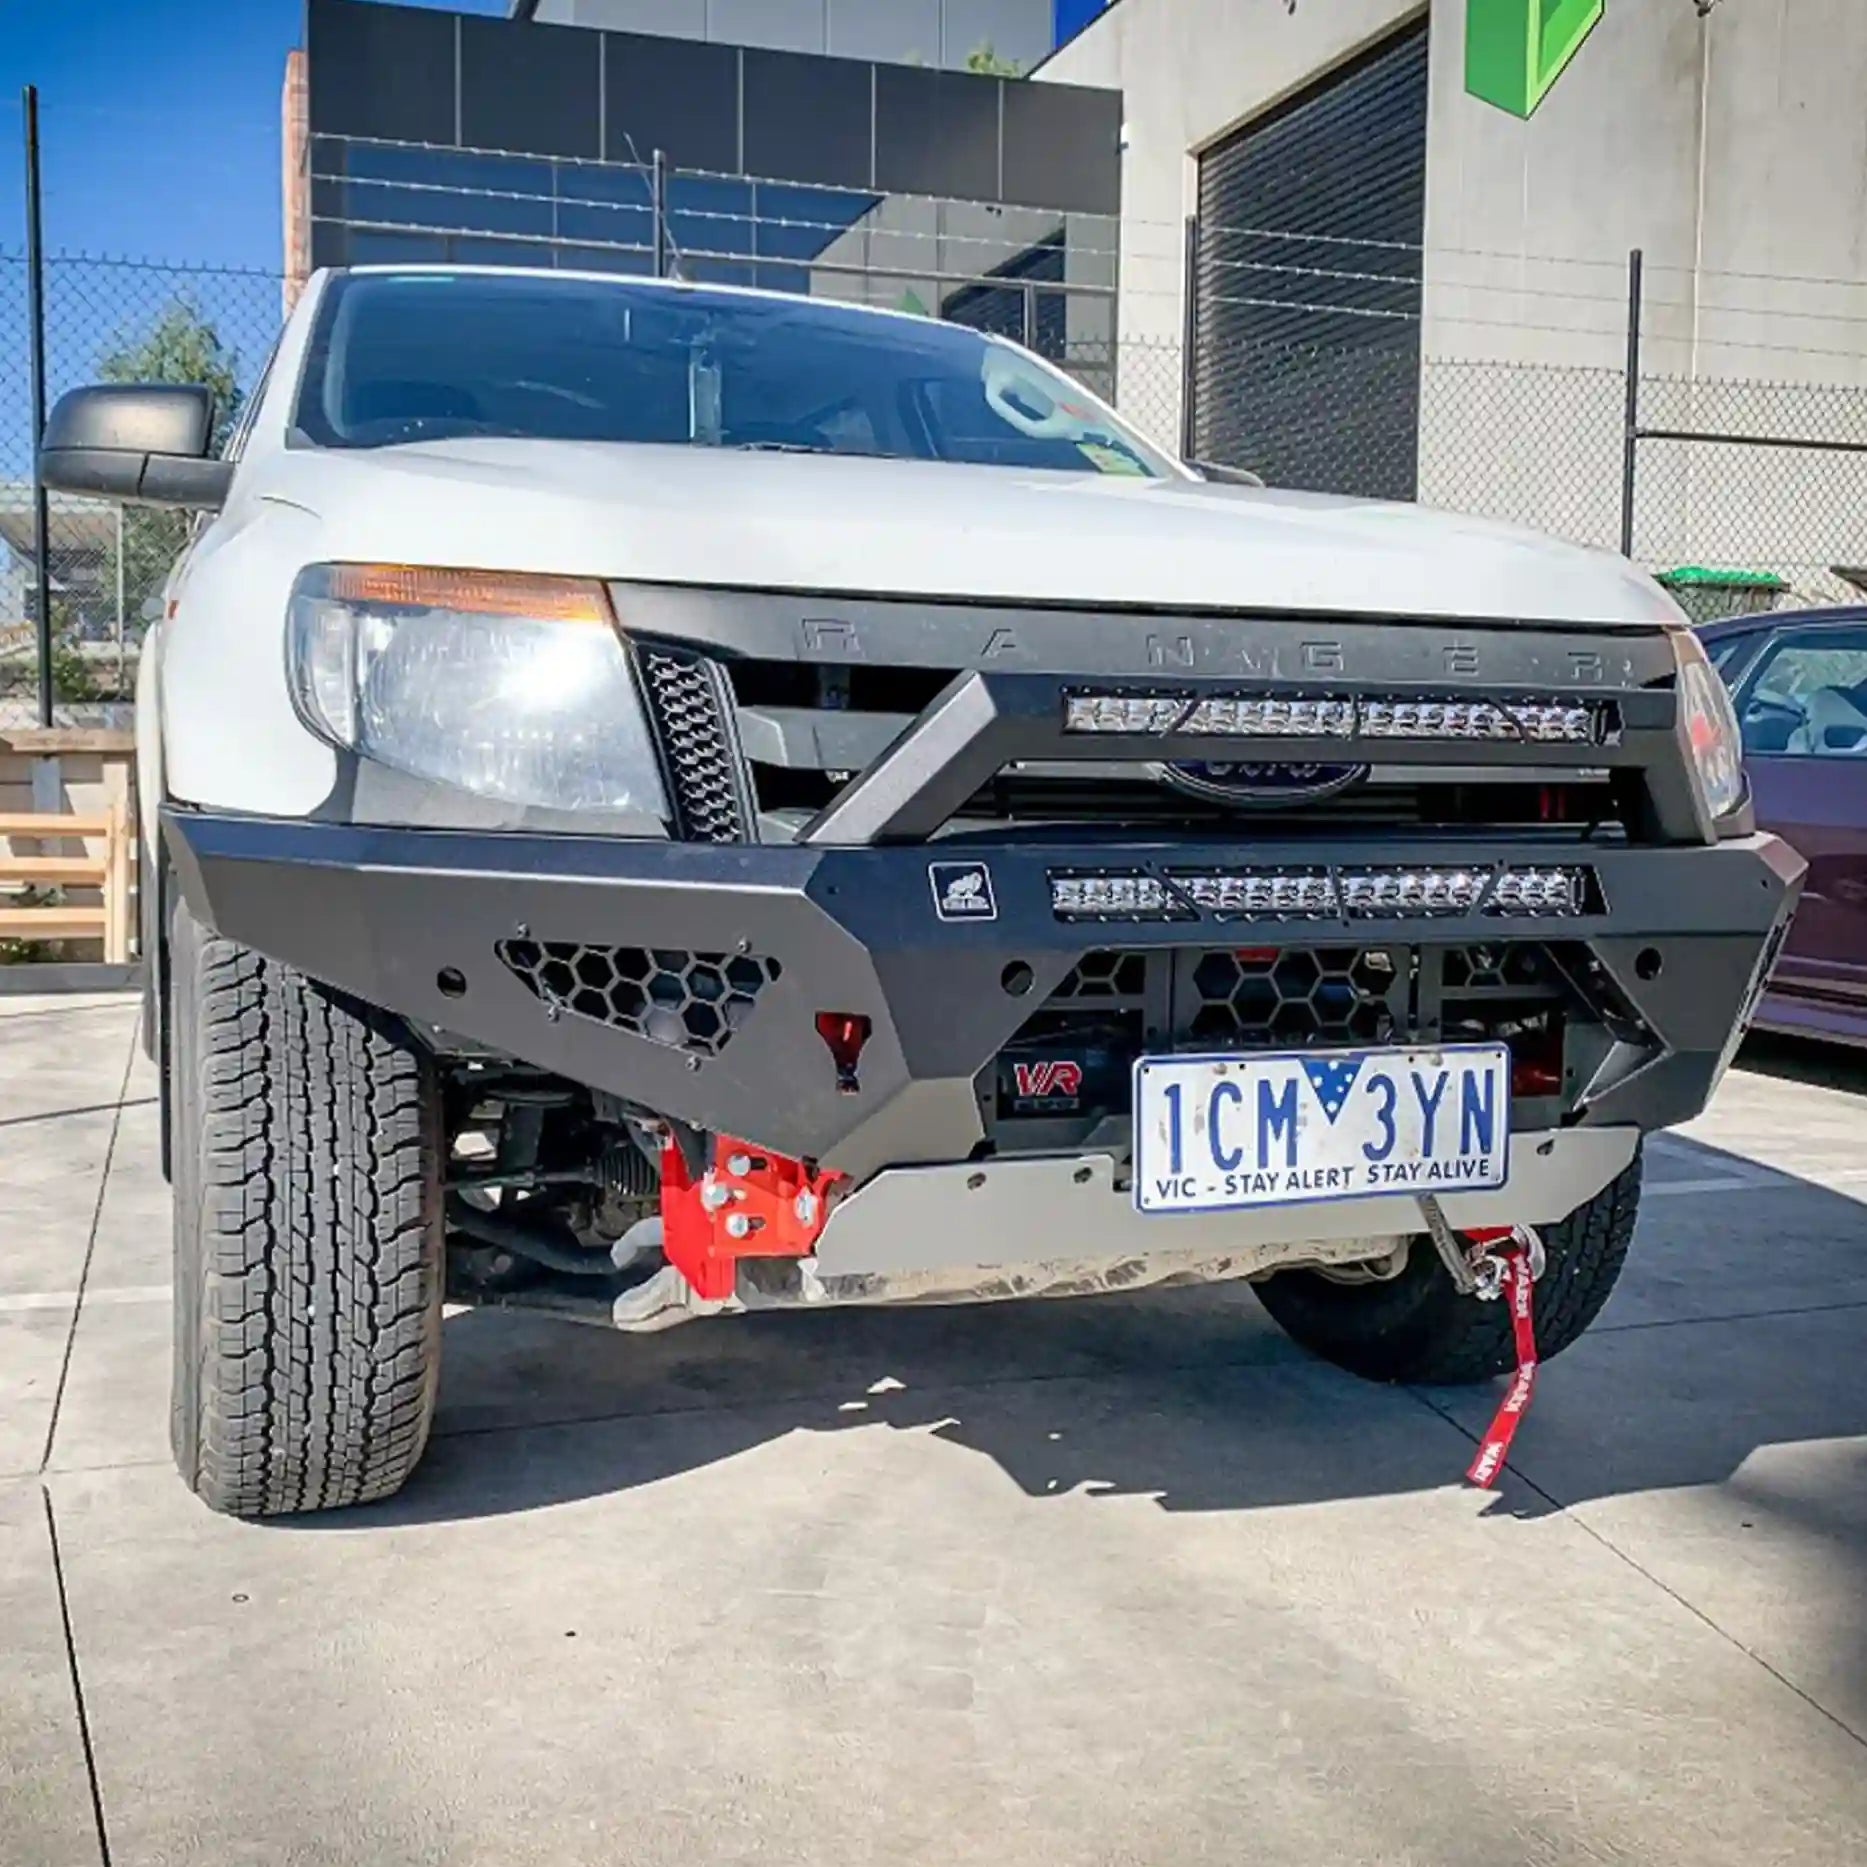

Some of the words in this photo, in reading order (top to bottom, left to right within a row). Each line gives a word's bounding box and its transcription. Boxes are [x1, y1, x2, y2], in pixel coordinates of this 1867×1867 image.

[1163, 1079, 1299, 1175] 1CM
[1362, 1068, 1495, 1163] 3YN
[1155, 1177, 1196, 1200] VIC
[1224, 1172, 1281, 1195] STAY
[1286, 1165, 1355, 1192] ALERT
[1366, 1162, 1422, 1184] STAY
[1428, 1157, 1490, 1180] ALIVE
